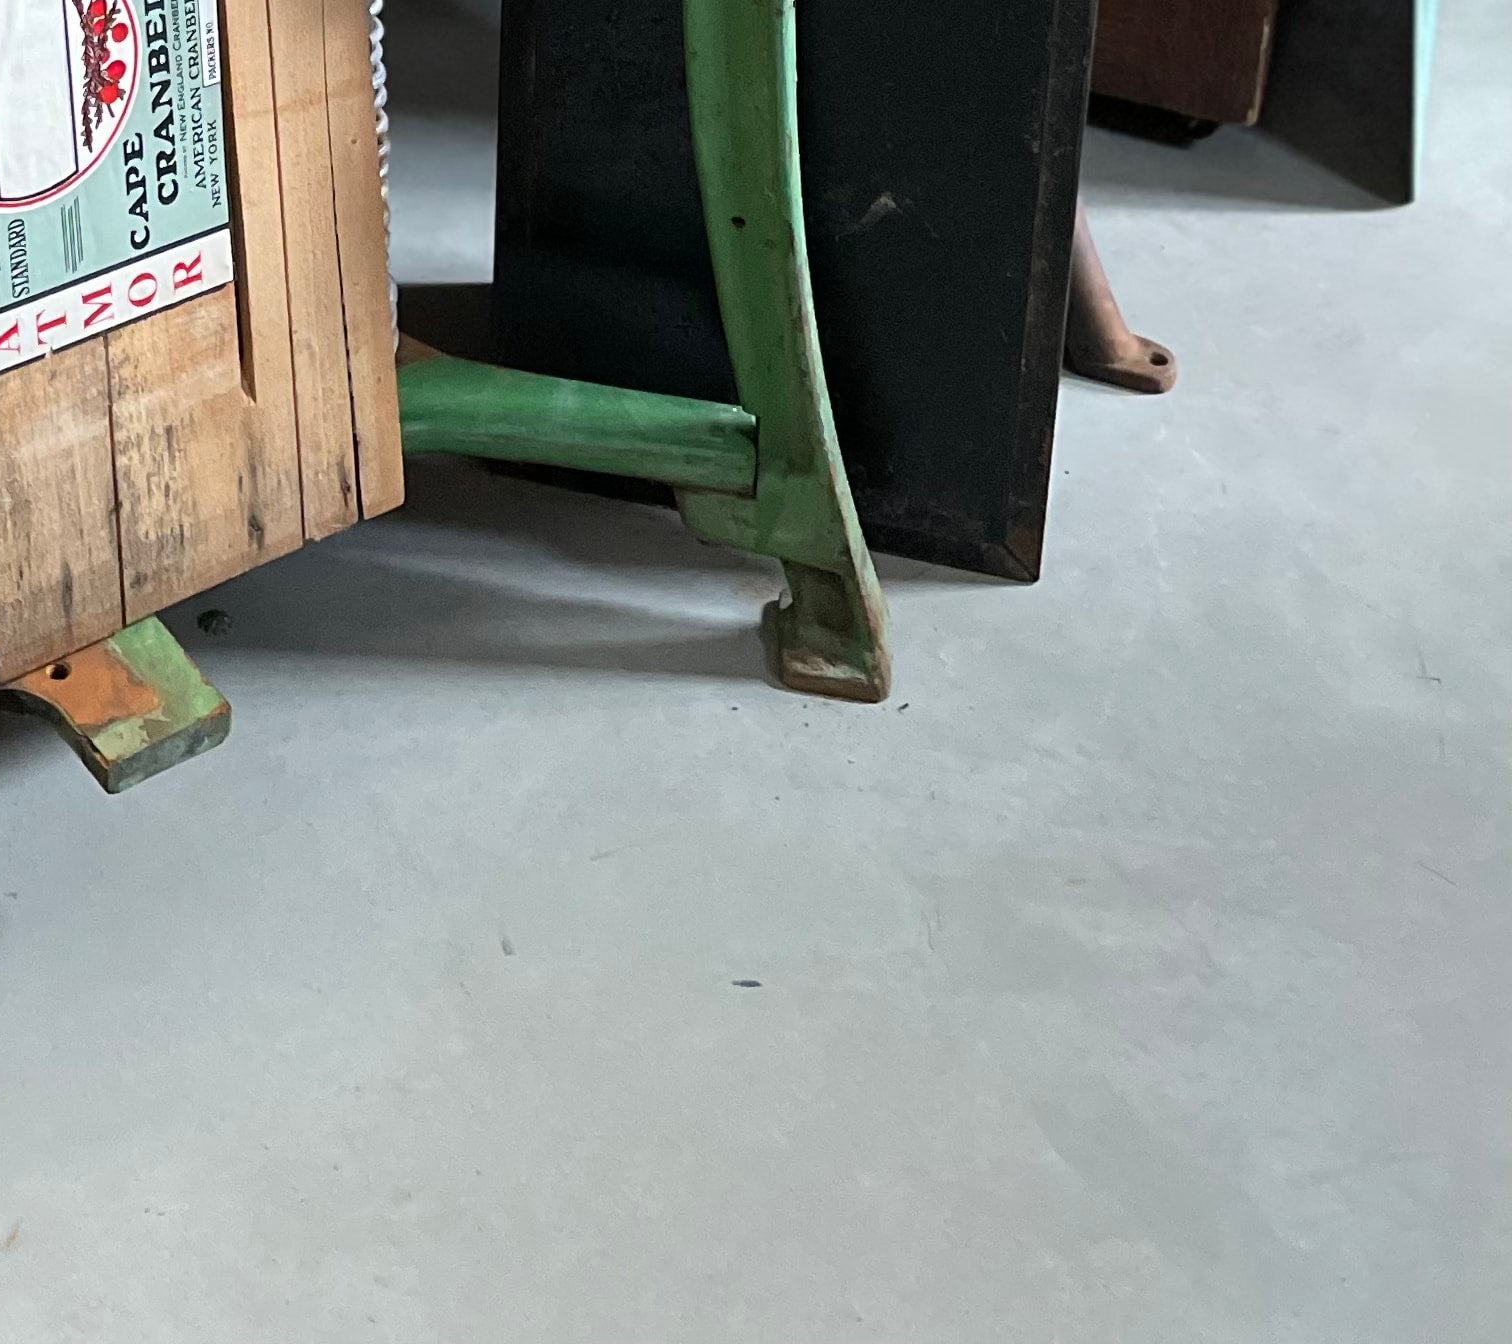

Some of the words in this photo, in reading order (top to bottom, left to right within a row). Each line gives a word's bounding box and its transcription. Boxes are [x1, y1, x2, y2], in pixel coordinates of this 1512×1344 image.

[206, 31, 217, 81] PACKERS
[189, 86, 207, 190] AMERICAN
[207, 119, 218, 166] YORK
[122, 132, 151, 250] CAPE
[210, 172, 222, 209] NEW
[7, 218, 30, 299] STANDARD
